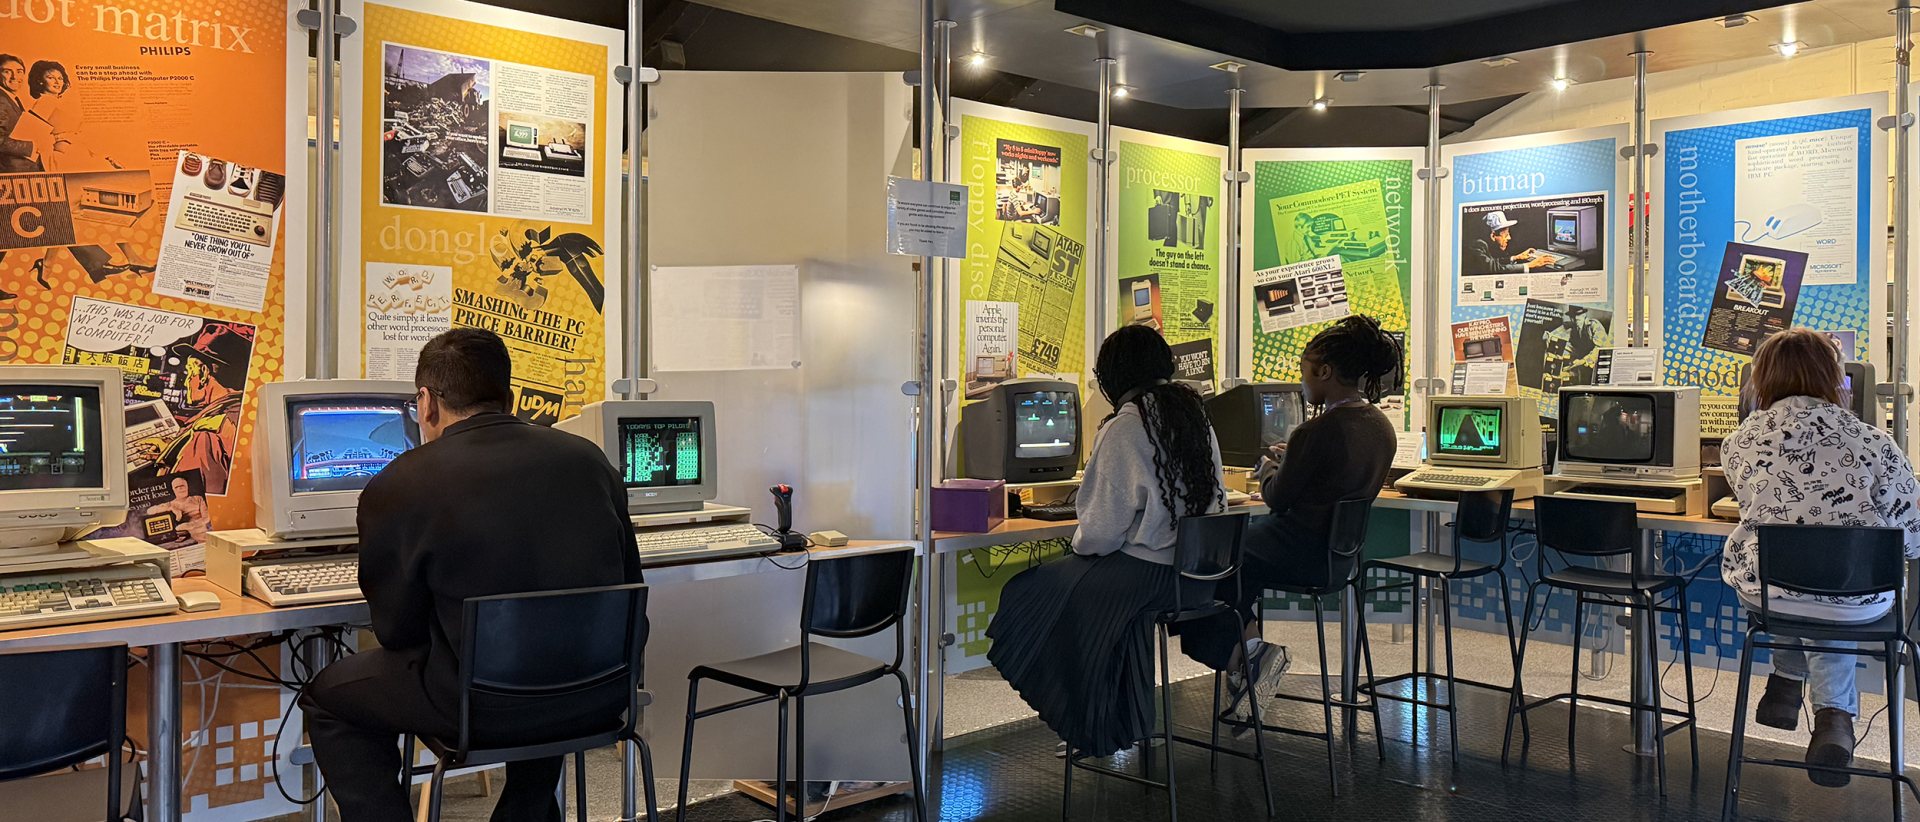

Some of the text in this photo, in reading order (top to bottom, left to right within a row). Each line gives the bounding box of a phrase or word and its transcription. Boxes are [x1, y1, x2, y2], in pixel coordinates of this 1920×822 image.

[93, 3, 255, 54] matrix
[140, 46, 191, 55] PHILIPS
[1125, 166, 1201, 192] processor
[1461, 170, 1545, 195] bitmap
[1276, 187, 1378, 211] Your Commodore PET System
[10, 206, 45, 239] C
[966, 138, 991, 298] floppy disc
[1384, 175, 1408, 273] network
[379, 215, 508, 265] dongle
[1678, 145, 1706, 320] motherboard
[184, 240, 206, 251] NEVER
[207, 244, 228, 255] GROW
[228, 248, 241, 258] OUT
[209, 236, 229, 247] THING
[230, 240, 252, 252] YOU'LL
[1056, 236, 1083, 258] ATARI
[1155, 248, 1166, 257] The
[1166, 251, 1176, 260] guy
[1184, 250, 1194, 260] the
[1194, 251, 1205, 261] left
[1051, 249, 1080, 278] ST
[1149, 257, 1169, 267] doesn't
[1169, 260, 1185, 269] stand
[1191, 260, 1211, 270] chance.
[1264, 268, 1280, 276] your
[1281, 261, 1314, 273] experience
[1315, 257, 1335, 267] grows
[1277, 273, 1293, 281] your
[1293, 267, 1311, 277] Atari
[1346, 267, 1375, 278] Network
[113, 307, 135, 320] WAS
[135, 312, 145, 322] A
[147, 315, 169, 325] JOB
[169, 317, 195, 329] FOR
[368, 312, 392, 322] Quite
[420, 313, 426, 322] it
[427, 313, 449, 322] leaves
[453, 287, 586, 335] SMASHING THE PC
[1733, 304, 1769, 316] BREAKOUT
[73, 314, 96, 325] MY
[367, 322, 388, 331] other
[389, 323, 410, 331] word
[975, 314, 998, 323] invents
[978, 318, 1005, 334] personal
[383, 331, 397, 341] lost
[398, 332, 408, 341] for
[454, 307, 577, 352] PRICE BARRIER!
[1030, 338, 1060, 363] £749
[1179, 353, 1191, 363] YOU
[1178, 357, 1211, 371] HAVE TO BIN
[1185, 368, 1191, 377] A
[1707, 425, 1720, 433] the
[150, 482, 167, 492] and
